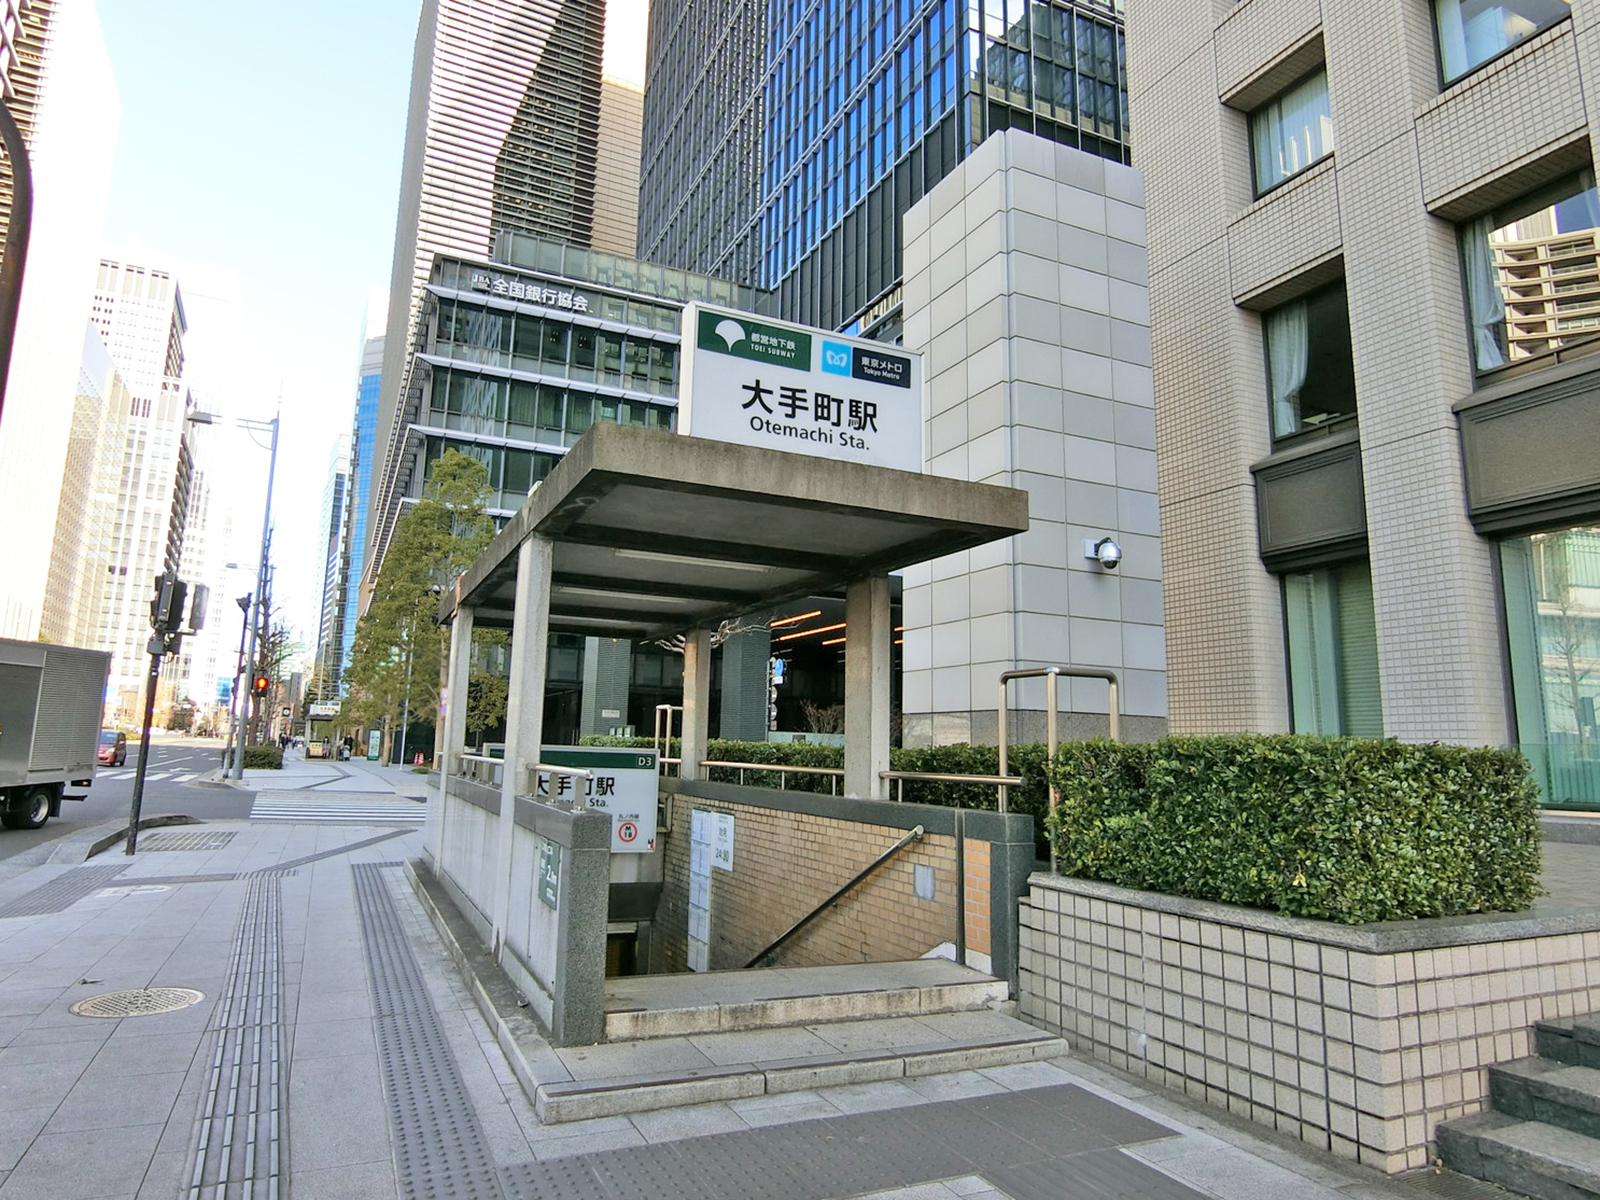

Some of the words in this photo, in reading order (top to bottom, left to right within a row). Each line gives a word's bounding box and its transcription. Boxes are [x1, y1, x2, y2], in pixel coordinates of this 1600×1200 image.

[492, 278, 588, 311] 全国銀行協会
[750, 332, 796, 350] 都営地下鉄
[751, 343, 767, 353] TOEI
[768, 347, 796, 359] SUBWAY
[861, 356, 903, 373] 東京メトロ
[863, 367, 881, 378] Tokyo
[882, 370, 900, 380] Metro
[741, 379, 878, 433] 大手町駅
[750, 416, 833, 444] Otemachi
[839, 432, 870, 451] Sta.
[638, 757, 652, 766] D3
[589, 798, 609, 808] Sta.
